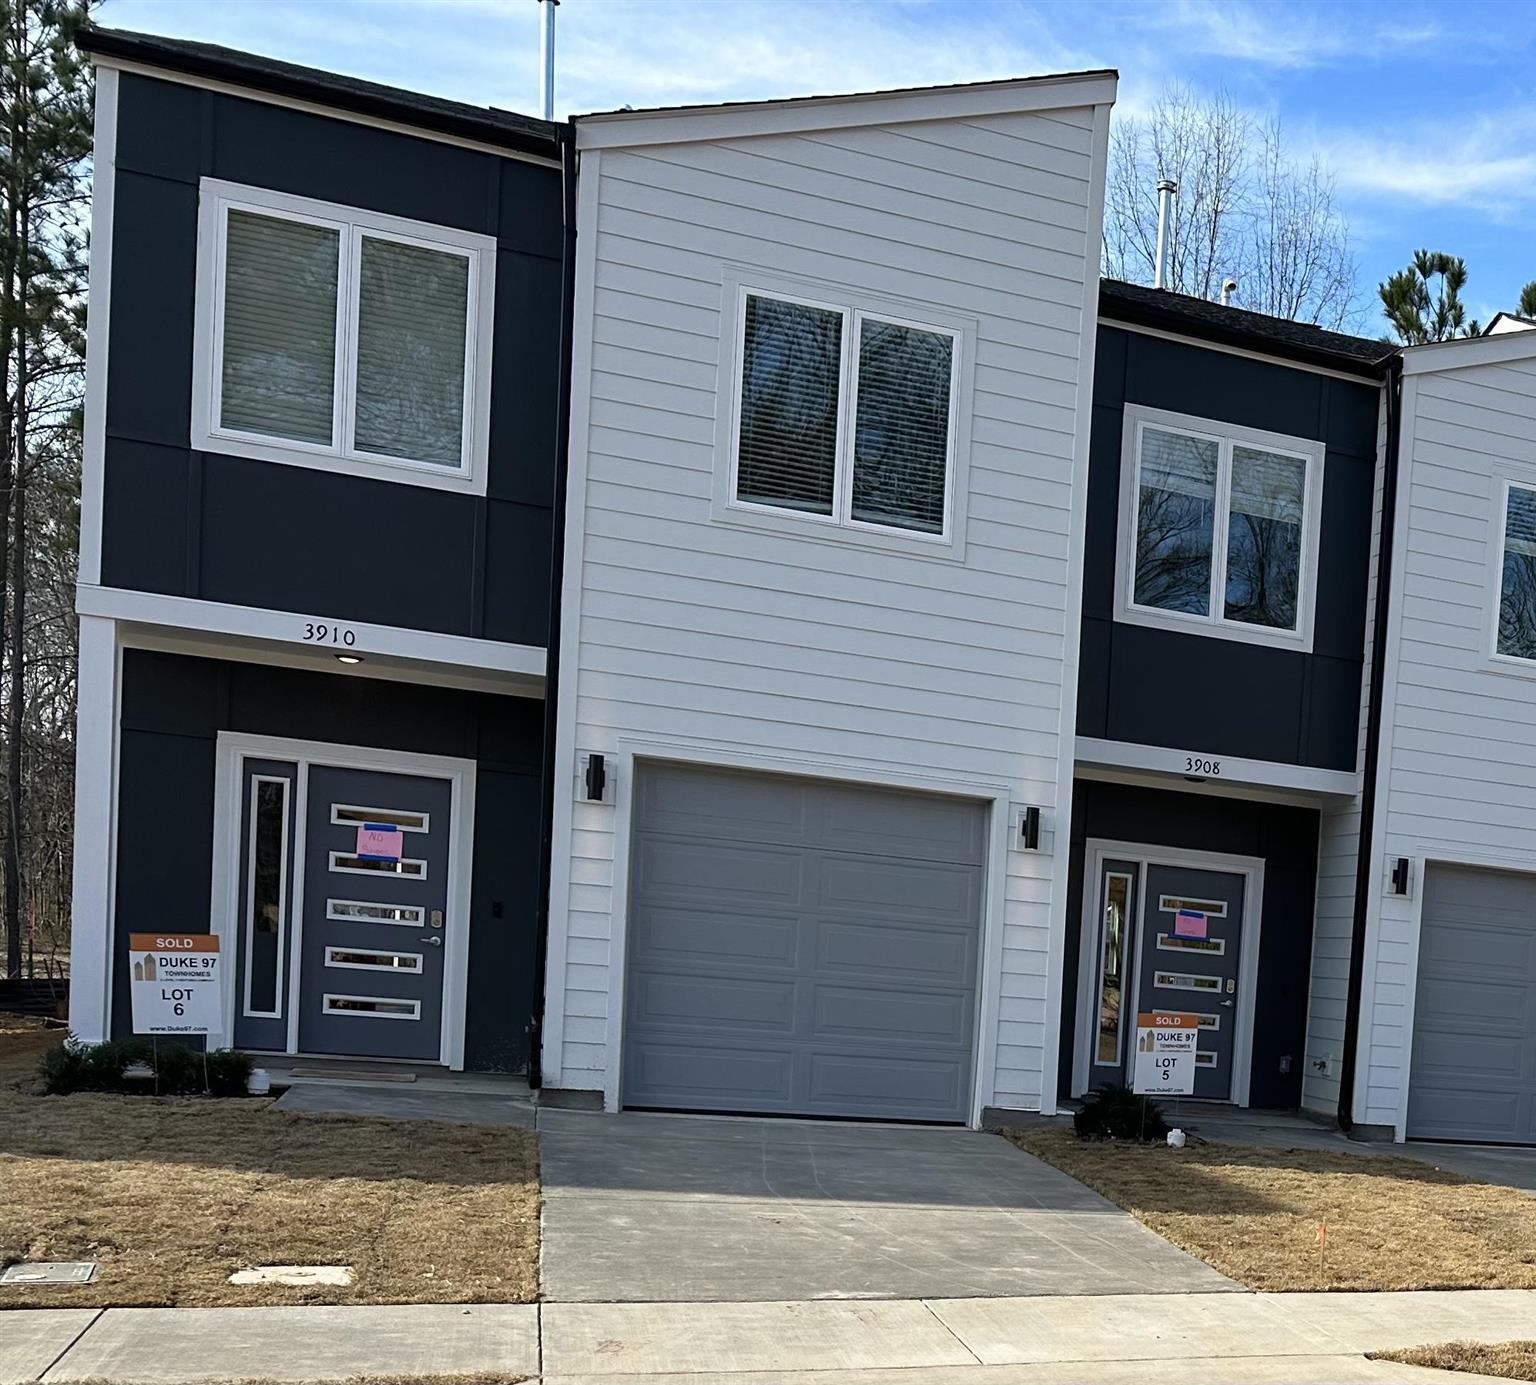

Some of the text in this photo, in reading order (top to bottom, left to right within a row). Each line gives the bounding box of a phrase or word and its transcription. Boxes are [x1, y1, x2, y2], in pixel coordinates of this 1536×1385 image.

[303, 623, 355, 646] 3910
[1185, 757, 1220, 775] 3908
[156, 938, 193, 948] SOLD
[159, 957, 217, 969] DUKE 97
[161, 988, 194, 1001] LOT
[173, 1002, 185, 1016] 6
[1155, 1016, 1181, 1025] SOLD
[1156, 1032, 1196, 1043] DUKE 97
[1155, 1058, 1178, 1068] LOT
[1161, 1069, 1170, 1081] 5
